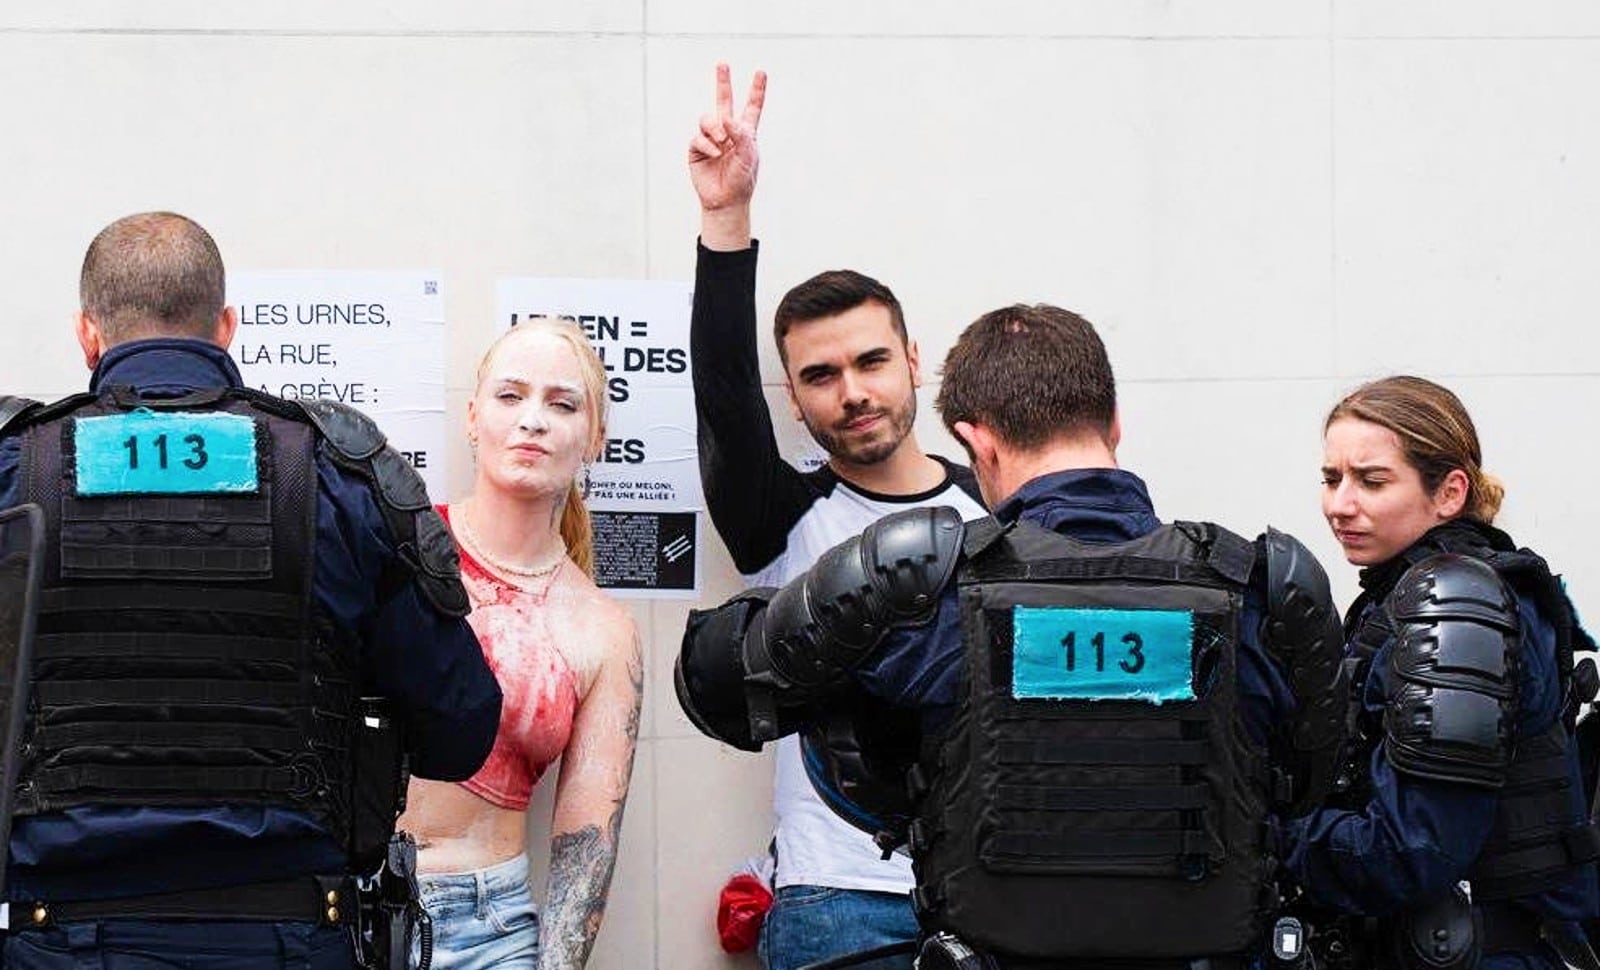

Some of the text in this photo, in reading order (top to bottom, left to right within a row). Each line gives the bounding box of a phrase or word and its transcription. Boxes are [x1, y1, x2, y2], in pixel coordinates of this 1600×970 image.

[241, 304, 391, 327] LES URNES,
[241, 344, 337, 367] LA RUE,
[623, 347, 687, 374] DES
[280, 377, 365, 403] GRÈVE
[123, 433, 208, 470] 113
[596, 438, 645, 464] ES
[616, 491, 634, 499] UNE
[1060, 631, 1145, 674] 113
